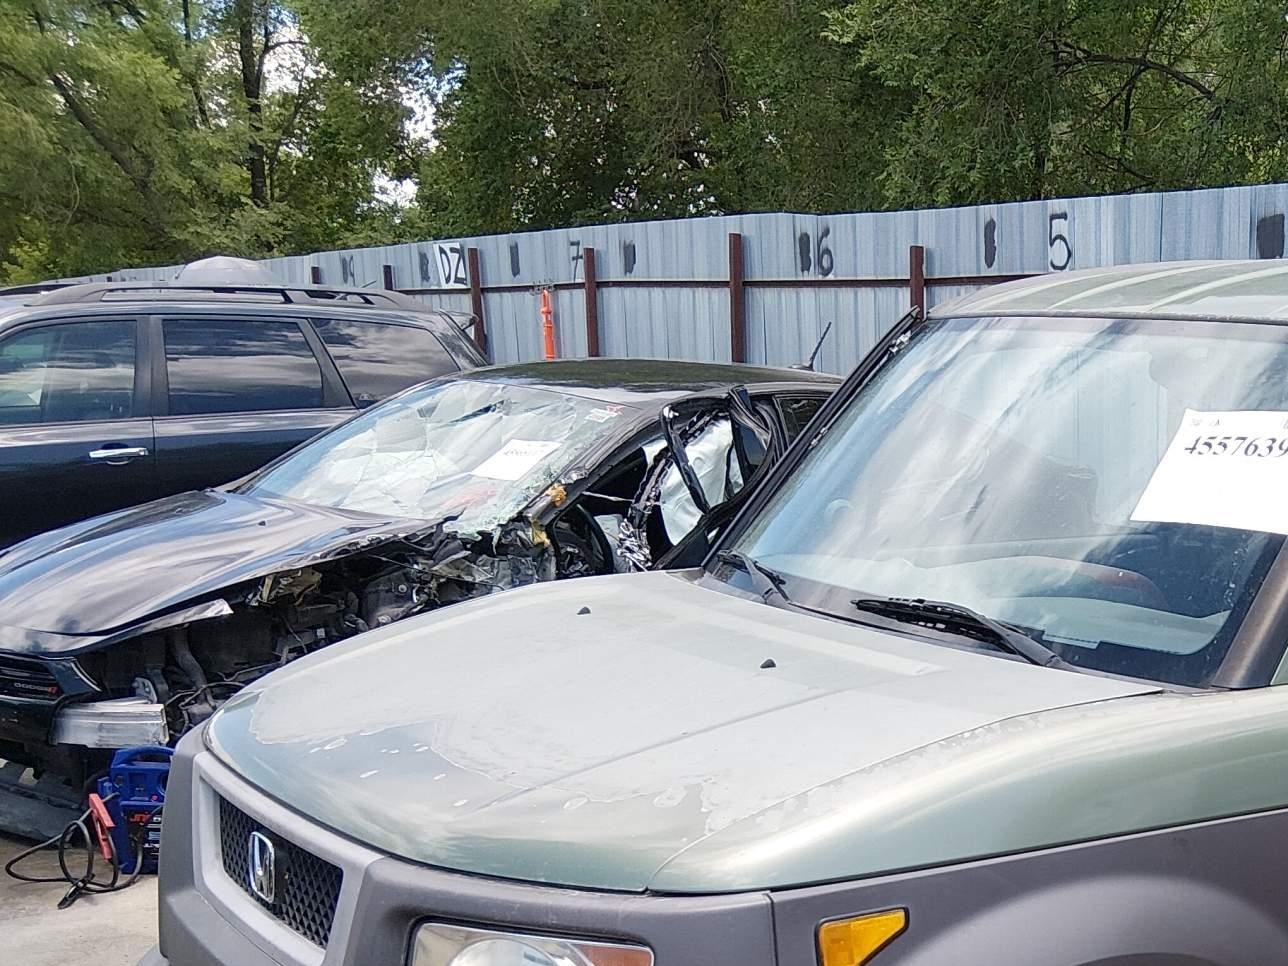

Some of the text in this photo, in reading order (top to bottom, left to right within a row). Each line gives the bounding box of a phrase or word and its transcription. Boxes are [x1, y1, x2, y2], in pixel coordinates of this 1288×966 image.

[569, 240, 584, 282] 7
[818, 225, 834, 278] 6
[1049, 211, 1073, 271] 5
